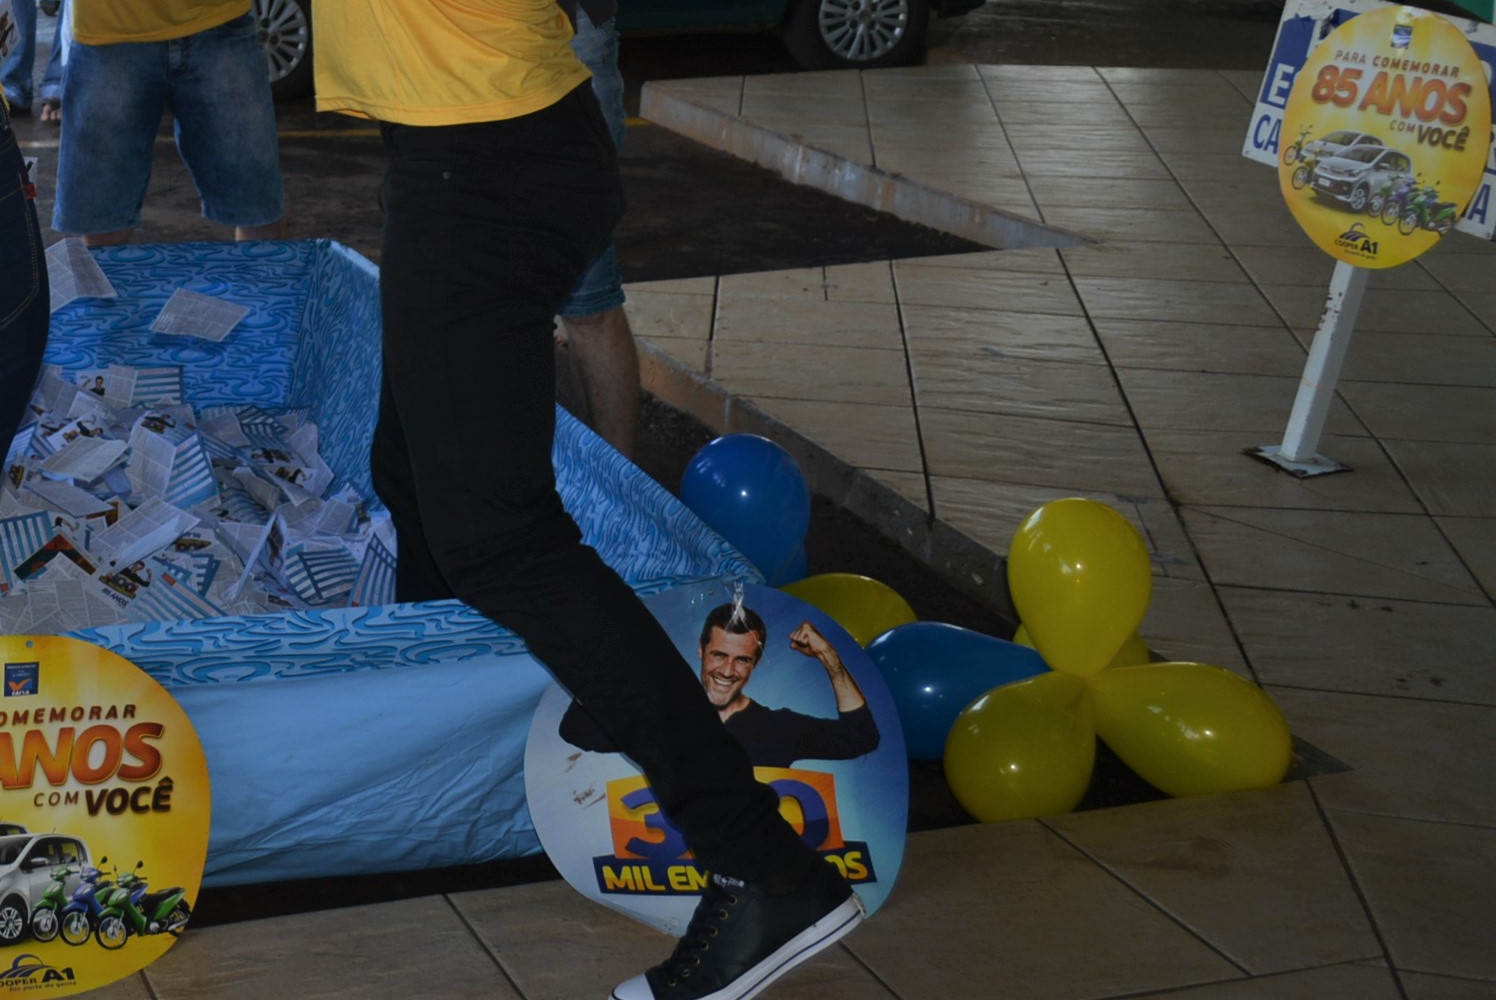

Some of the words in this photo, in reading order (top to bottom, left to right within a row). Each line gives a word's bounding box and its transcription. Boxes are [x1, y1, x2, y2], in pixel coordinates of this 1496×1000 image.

[1334, 50, 1367, 65] PARA
[1372, 55, 1461, 78] COMEMORAR
[1311, 64, 1363, 107] 85
[1358, 71, 1473, 126] ANOS
[1390, 119, 1416, 133] COM
[1416, 125, 1471, 152] VOCÊ
[34, 792, 79, 808] COM
[86, 776, 175, 817] VOCÊ
[620, 778, 831, 860] 30
[601, 864, 667, 892] MIL
[41, 966, 76, 983] A1
